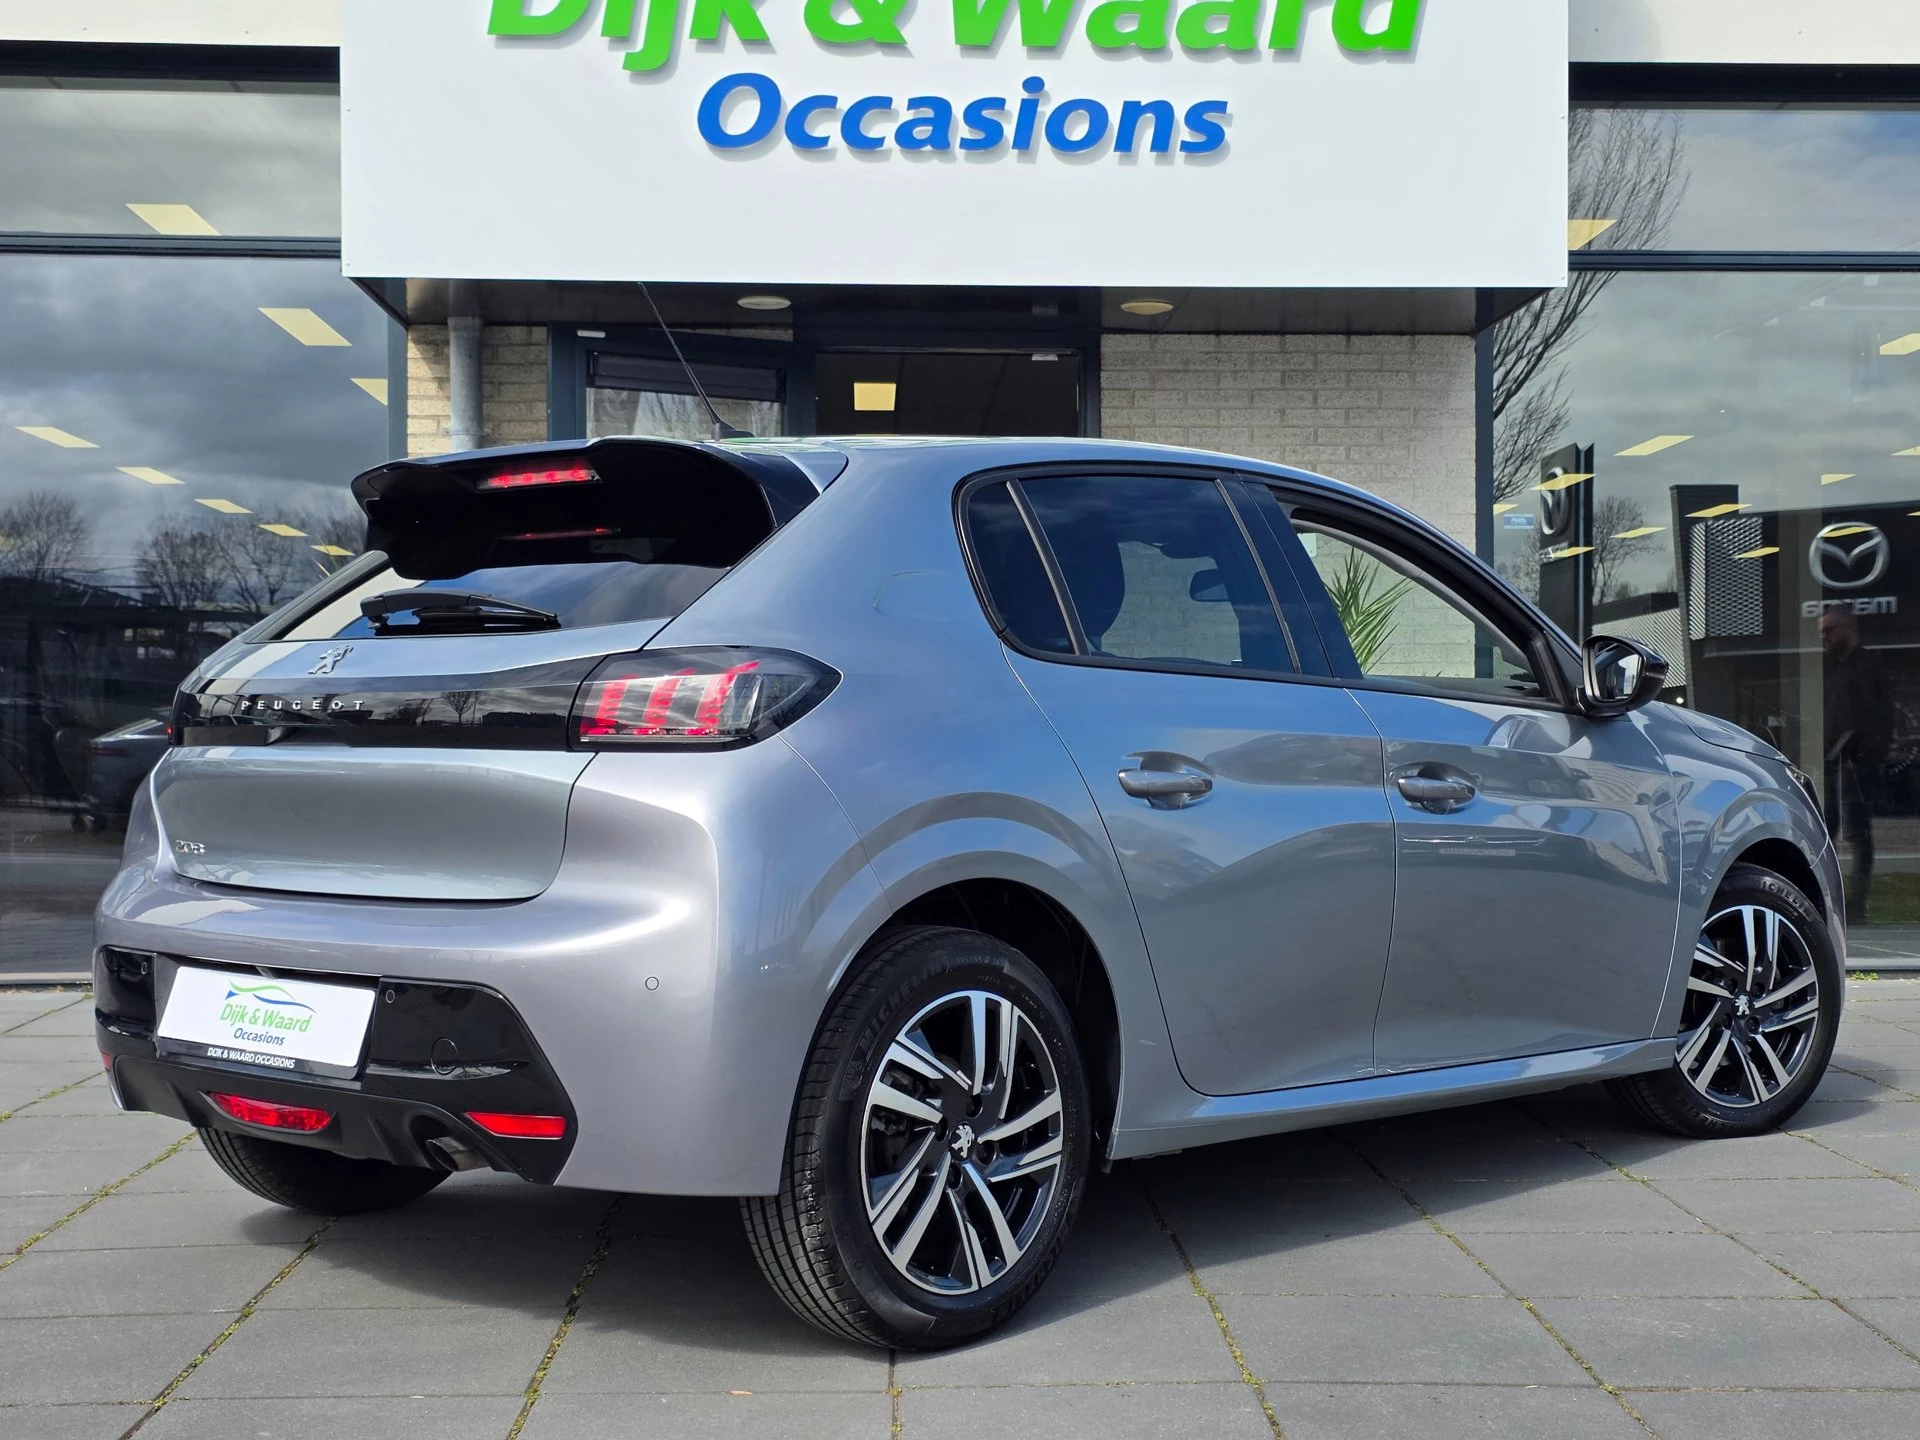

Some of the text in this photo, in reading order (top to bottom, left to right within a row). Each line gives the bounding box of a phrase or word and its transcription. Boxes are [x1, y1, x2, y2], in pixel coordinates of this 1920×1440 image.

[697, 73, 1229, 153] Occasions
[241, 700, 364, 711] PEUGEOT
[220, 1003, 313, 1033] Dijk & Waard
[233, 1027, 286, 1046] Occasions
[222, 1049, 229, 1059] &
[229, 1050, 255, 1063] WAARD
[255, 1054, 296, 1069] OCCASIONS
